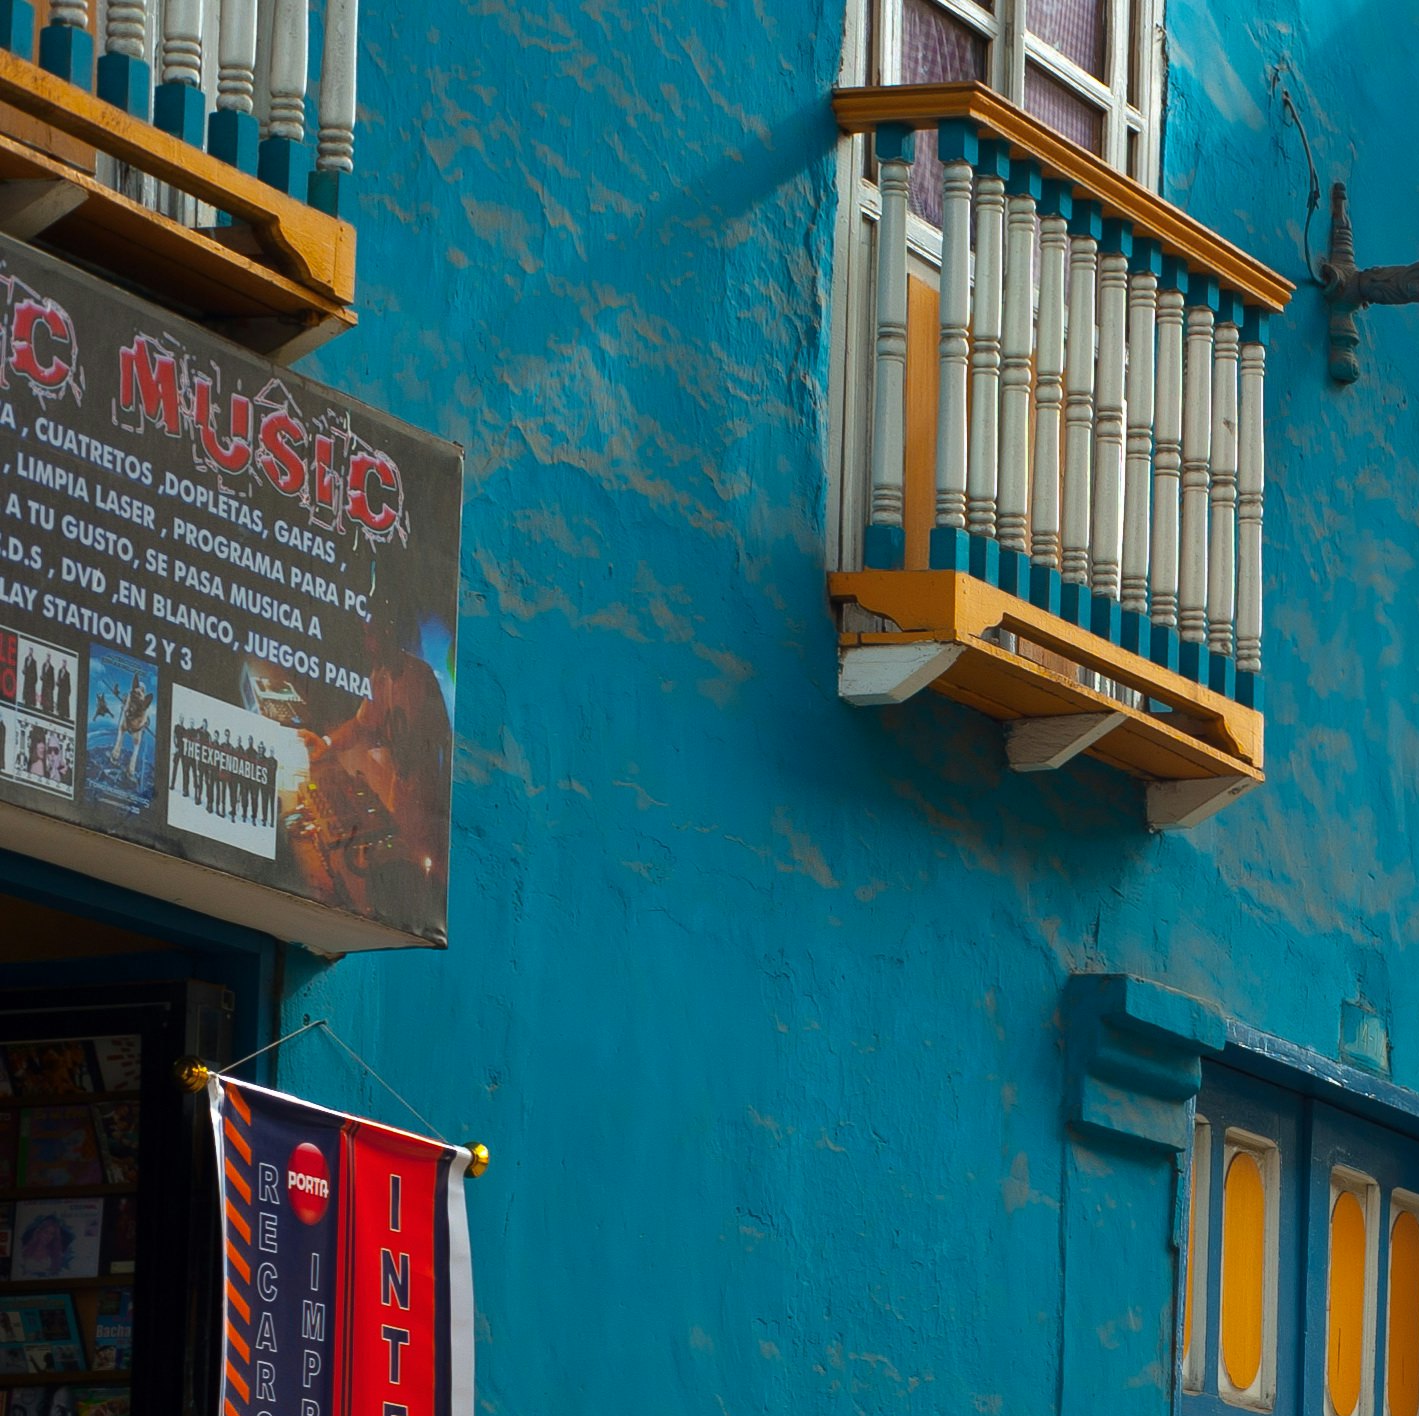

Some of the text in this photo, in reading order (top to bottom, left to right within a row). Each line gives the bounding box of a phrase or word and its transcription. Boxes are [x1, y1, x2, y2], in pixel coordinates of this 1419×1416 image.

[34, 416, 154, 487] CUATRETOS
[115, 333, 404, 538] MUSIC
[4, 492, 22, 520] A
[27, 499, 56, 531] TU
[145, 548, 169, 578] SE
[173, 559, 226, 601] PASA
[229, 583, 304, 633] MUSICA
[307, 615, 323, 641] A
[16, 451, 90, 503] LIMPIA
[95, 484, 156, 530] LASER
[172, 516, 286, 585] PROGRAMA
[290, 566, 340, 607] PARA
[42, 593, 133, 648] STATION
[144, 632, 158, 658] 2
[162, 638, 176, 664] Y
[180, 647, 193, 671] 3
[61, 556, 107, 594] DVD
[244, 631, 321, 679] JUEGOS
[325, 662, 373, 700] PARA
[181, 737, 268, 785] THE EXPENDABLES
[287, 1170, 330, 1199] PORTA
